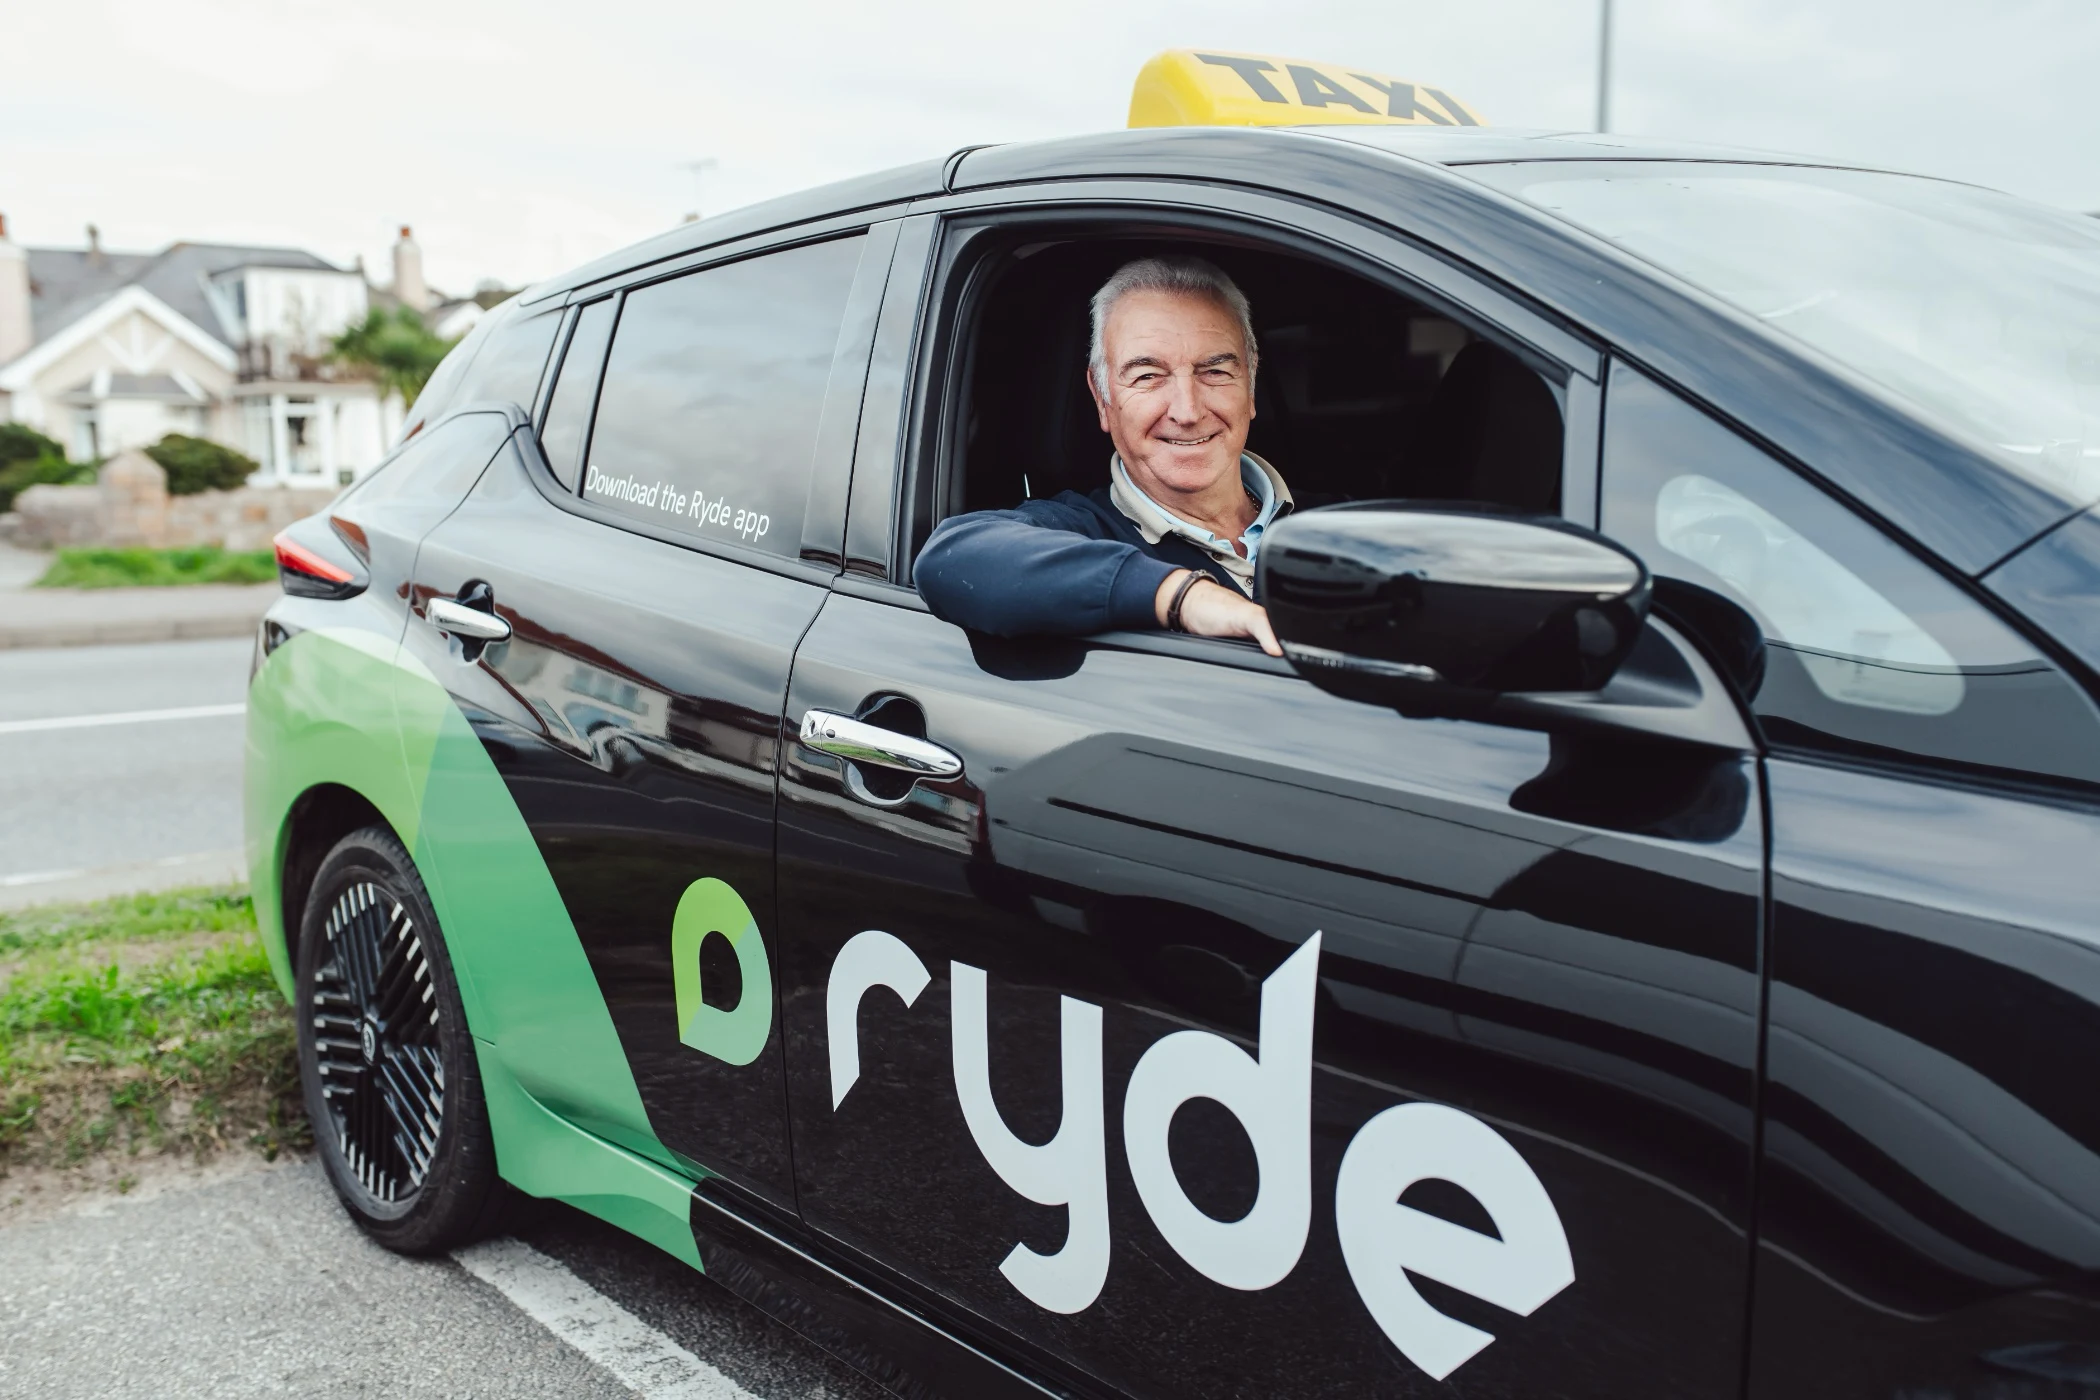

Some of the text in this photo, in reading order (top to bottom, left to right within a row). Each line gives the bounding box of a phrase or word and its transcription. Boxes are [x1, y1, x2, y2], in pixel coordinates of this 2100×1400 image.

[1193, 53, 1480, 127] TAXI
[586, 465, 770, 542] Download the Ryde app
[826, 930, 1575, 1382] ryde
